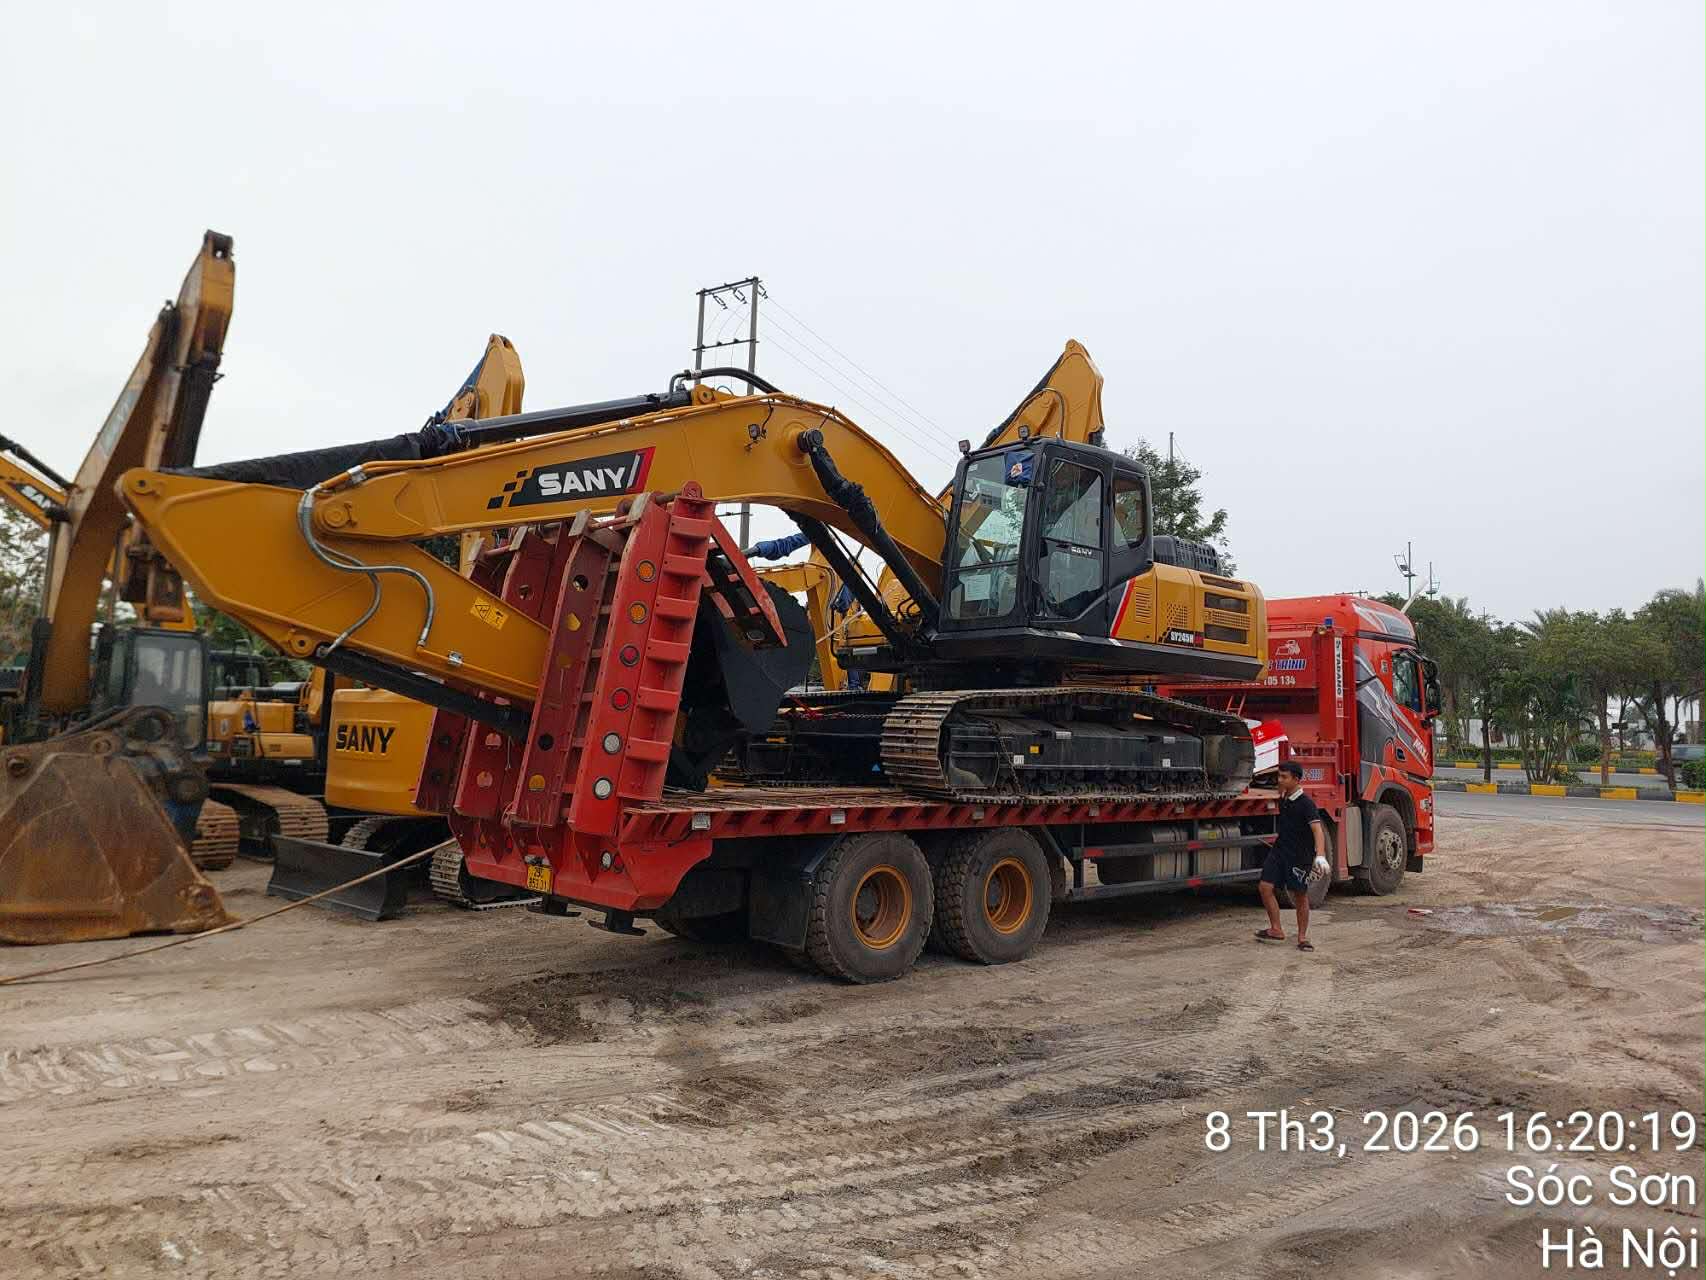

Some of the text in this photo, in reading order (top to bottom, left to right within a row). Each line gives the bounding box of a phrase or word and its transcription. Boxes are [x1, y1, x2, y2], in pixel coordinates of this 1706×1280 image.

[538, 466, 626, 496] SANY
[21, 485, 57, 509] SAN
[335, 725, 396, 754] SANY
